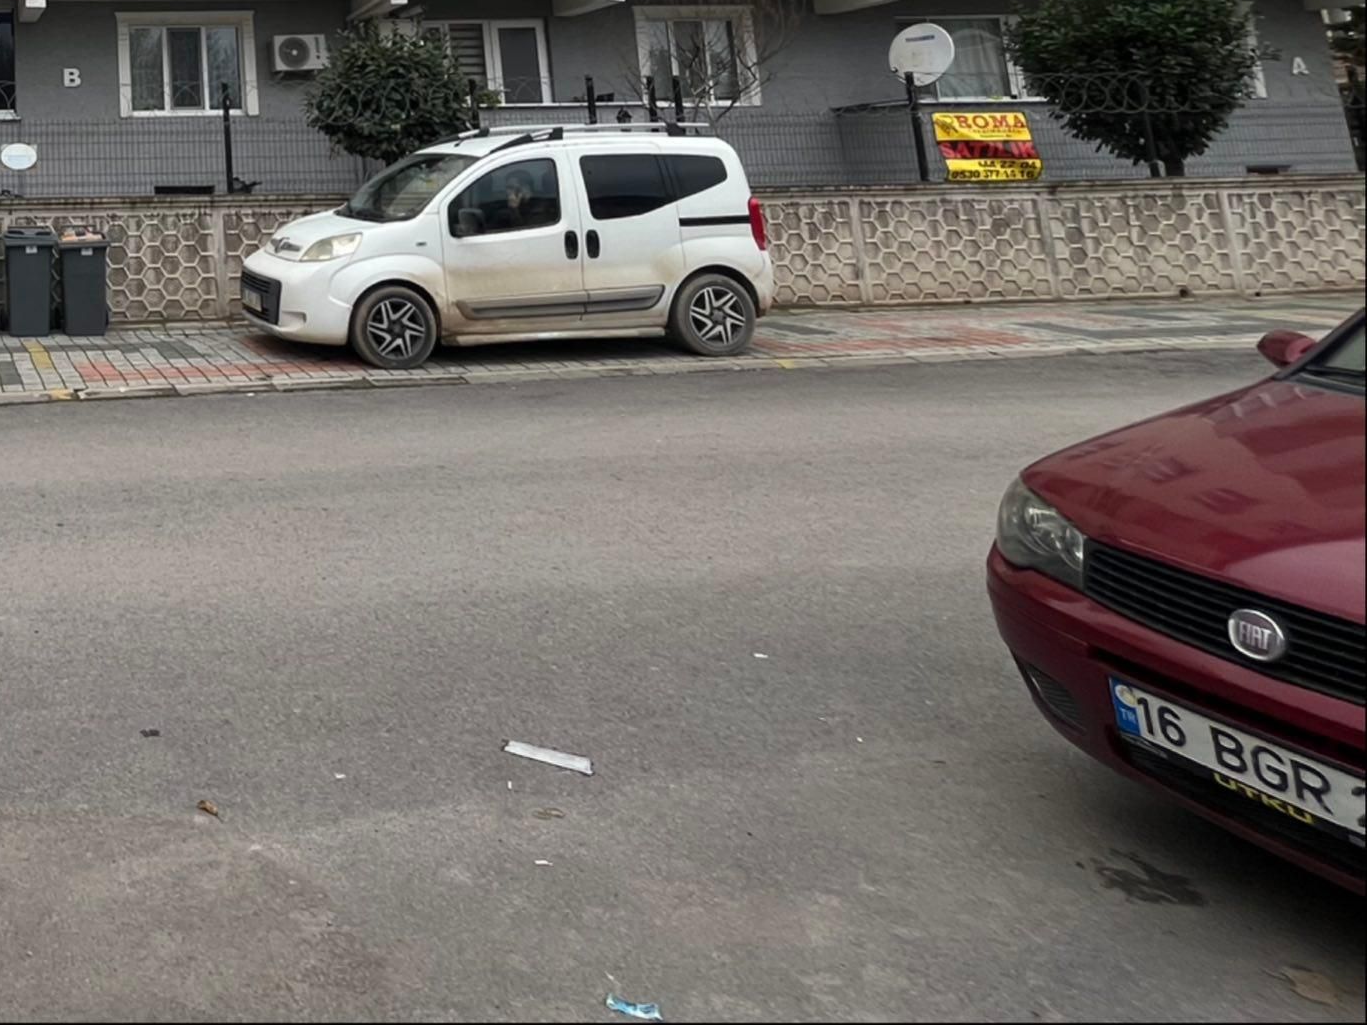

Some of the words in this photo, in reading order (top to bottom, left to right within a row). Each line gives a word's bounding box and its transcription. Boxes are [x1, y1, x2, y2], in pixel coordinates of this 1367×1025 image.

[1292, 57, 1310, 74] A
[63, 68, 81, 87] B
[954, 115, 1026, 128] ROMA
[1238, 620, 1272, 650] FIAT
[1137, 696, 1186, 747] 16
[1209, 725, 1334, 816] BGR
